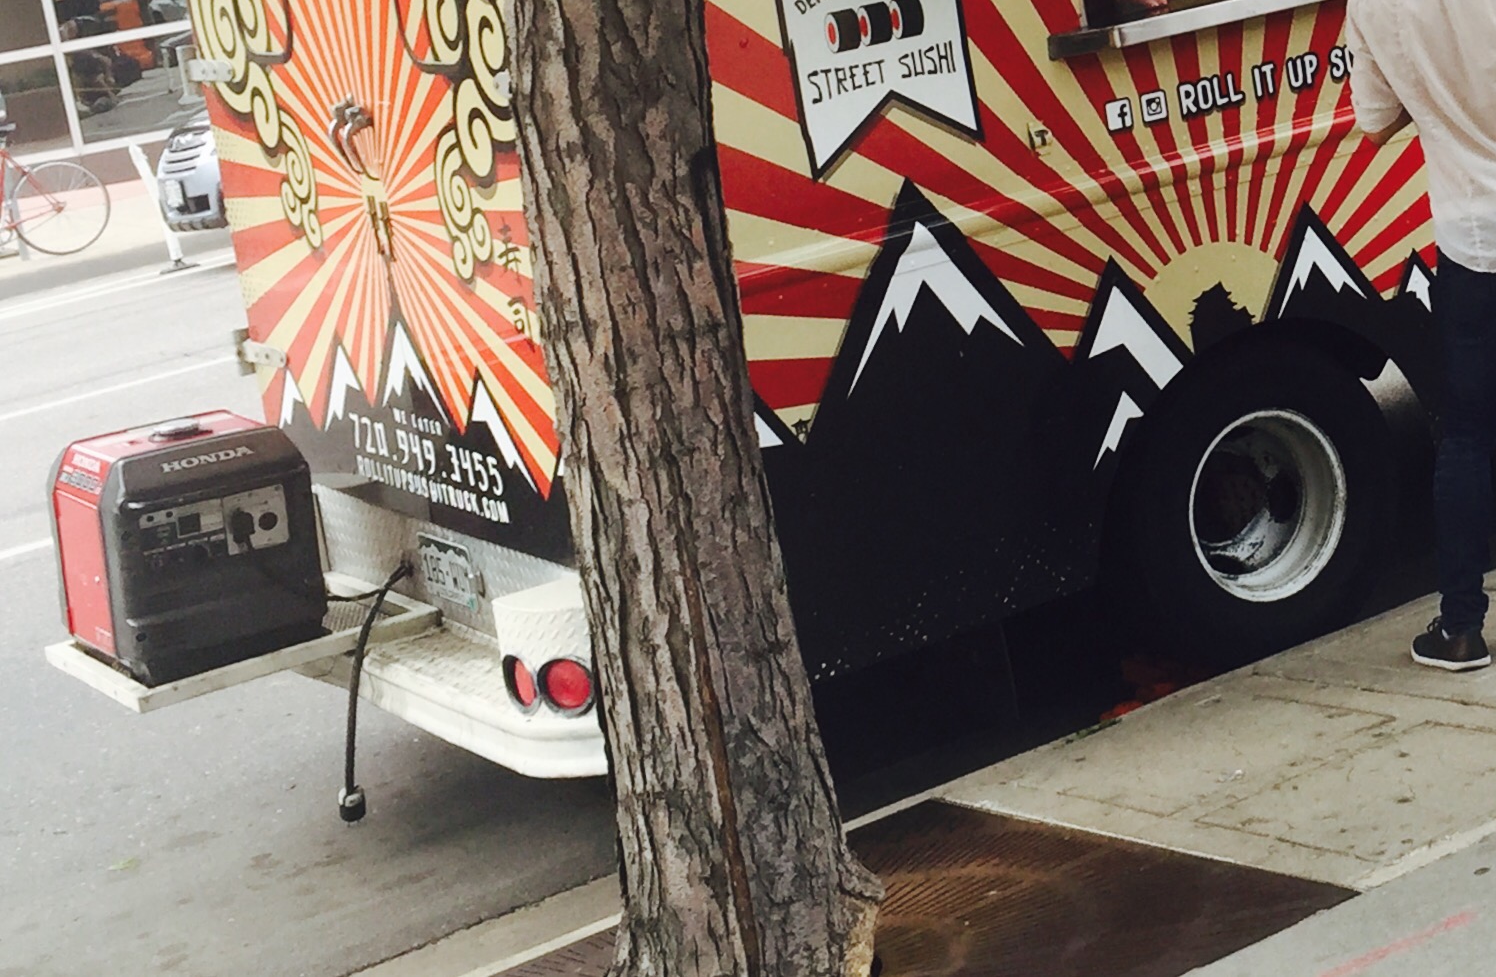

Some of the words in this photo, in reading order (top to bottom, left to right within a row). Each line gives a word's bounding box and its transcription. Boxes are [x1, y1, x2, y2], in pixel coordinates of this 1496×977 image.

[807, 58, 885, 105] STREET
[898, 40, 957, 79] SUSHI
[1178, 72, 1244, 116] ROLL
[1253, 62, 1276, 98] IT
[1286, 53, 1318, 89] UP
[393, 407, 407, 425] WE
[160, 445, 254, 474] HONDA
[349, 412, 504, 496] 720.949.3455
